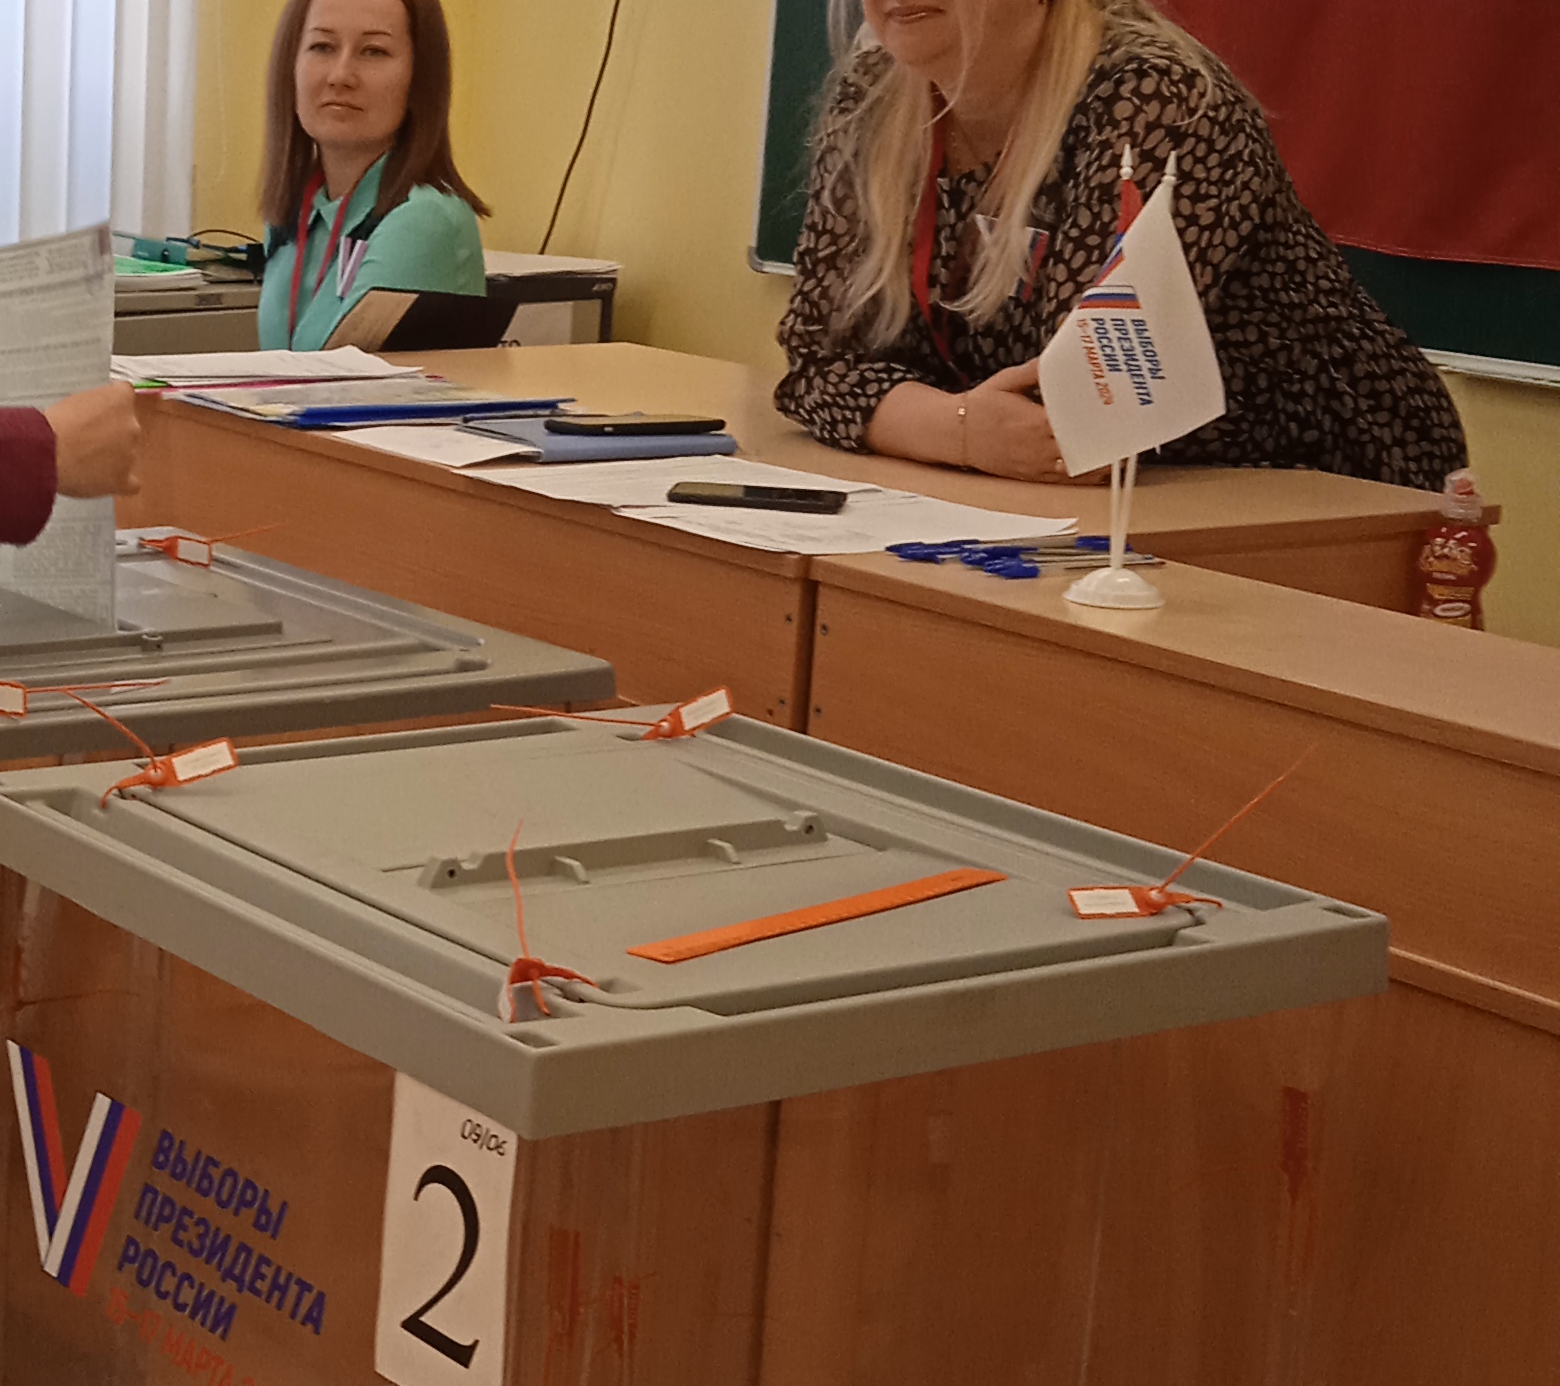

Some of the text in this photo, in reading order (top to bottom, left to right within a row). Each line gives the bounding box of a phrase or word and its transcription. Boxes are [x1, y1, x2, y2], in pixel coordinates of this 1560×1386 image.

[1090, 318, 1123, 372] РОССИИ
[1110, 318, 1154, 406] ПРЕЗИДЕНТА
[1130, 319, 1166, 380] ВЫБОРЫ
[151, 1128, 289, 1241] ВЫБОРЫ
[116, 1234, 237, 1342] РОССИИ
[134, 1182, 328, 1336] ПРЕЗИДЕНТА
[399, 1164, 480, 1369] 2
